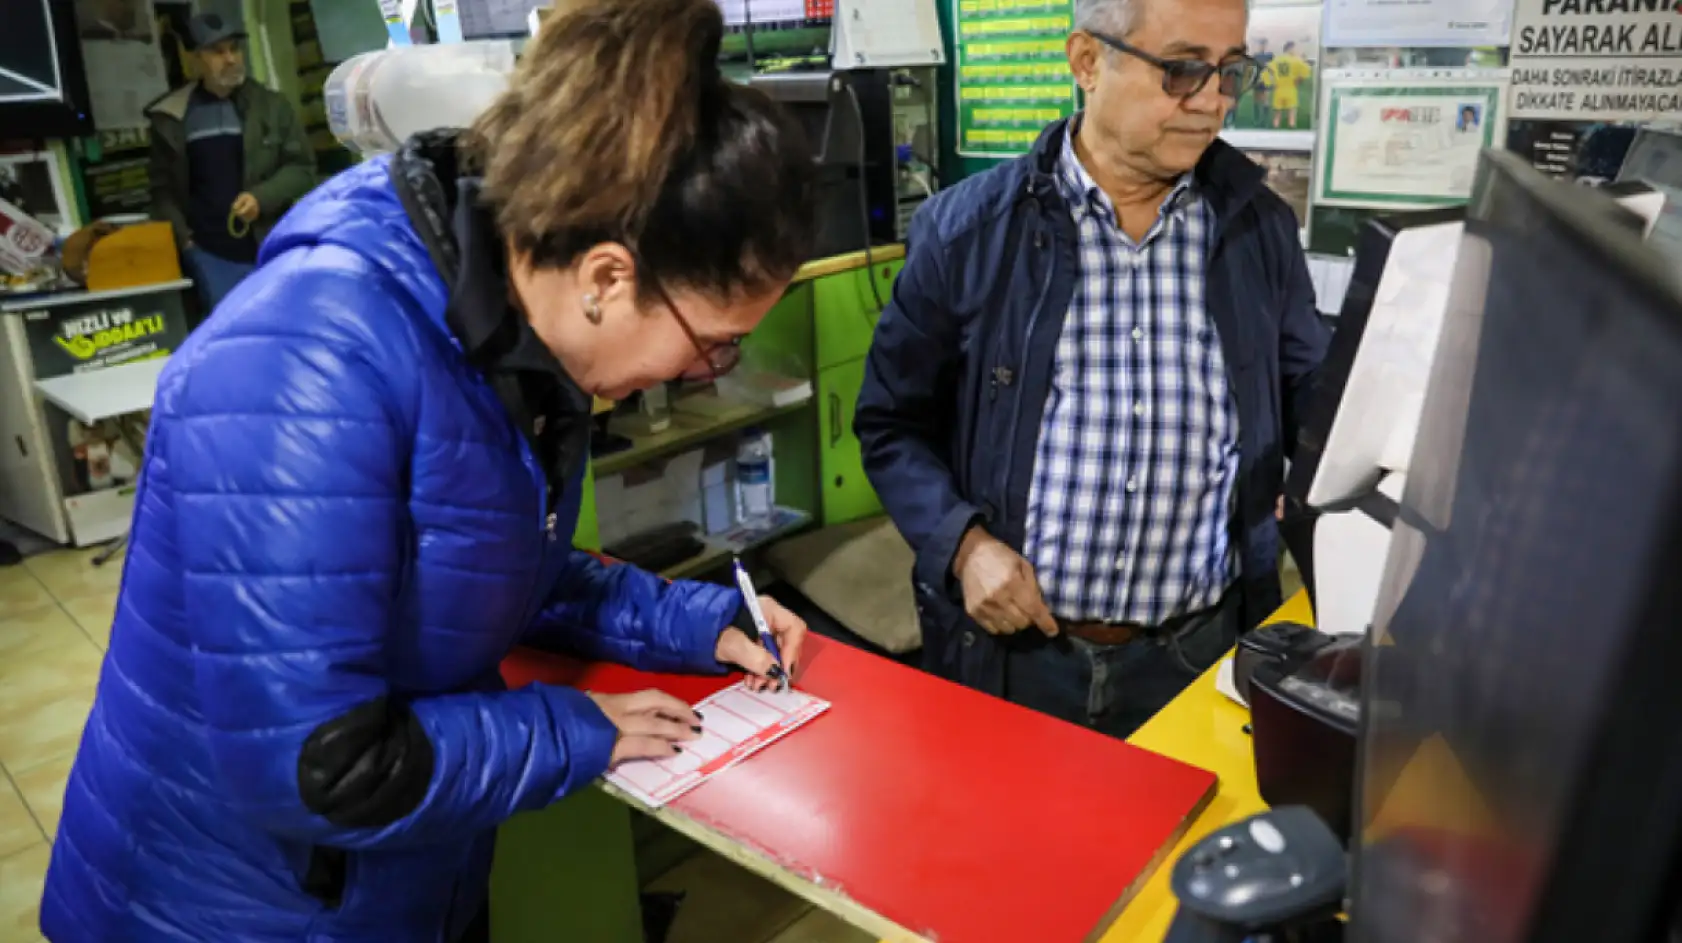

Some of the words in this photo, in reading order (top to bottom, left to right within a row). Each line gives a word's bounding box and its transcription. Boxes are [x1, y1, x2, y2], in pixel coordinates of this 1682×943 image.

[1519, 24, 1637, 53] SAYARAK
[1640, 22, 1682, 52] AL
[1512, 68, 1548, 86] DAHA
[1516, 89, 1575, 110] DİKKATE
[1579, 92, 1682, 112] ALINMAYACA
